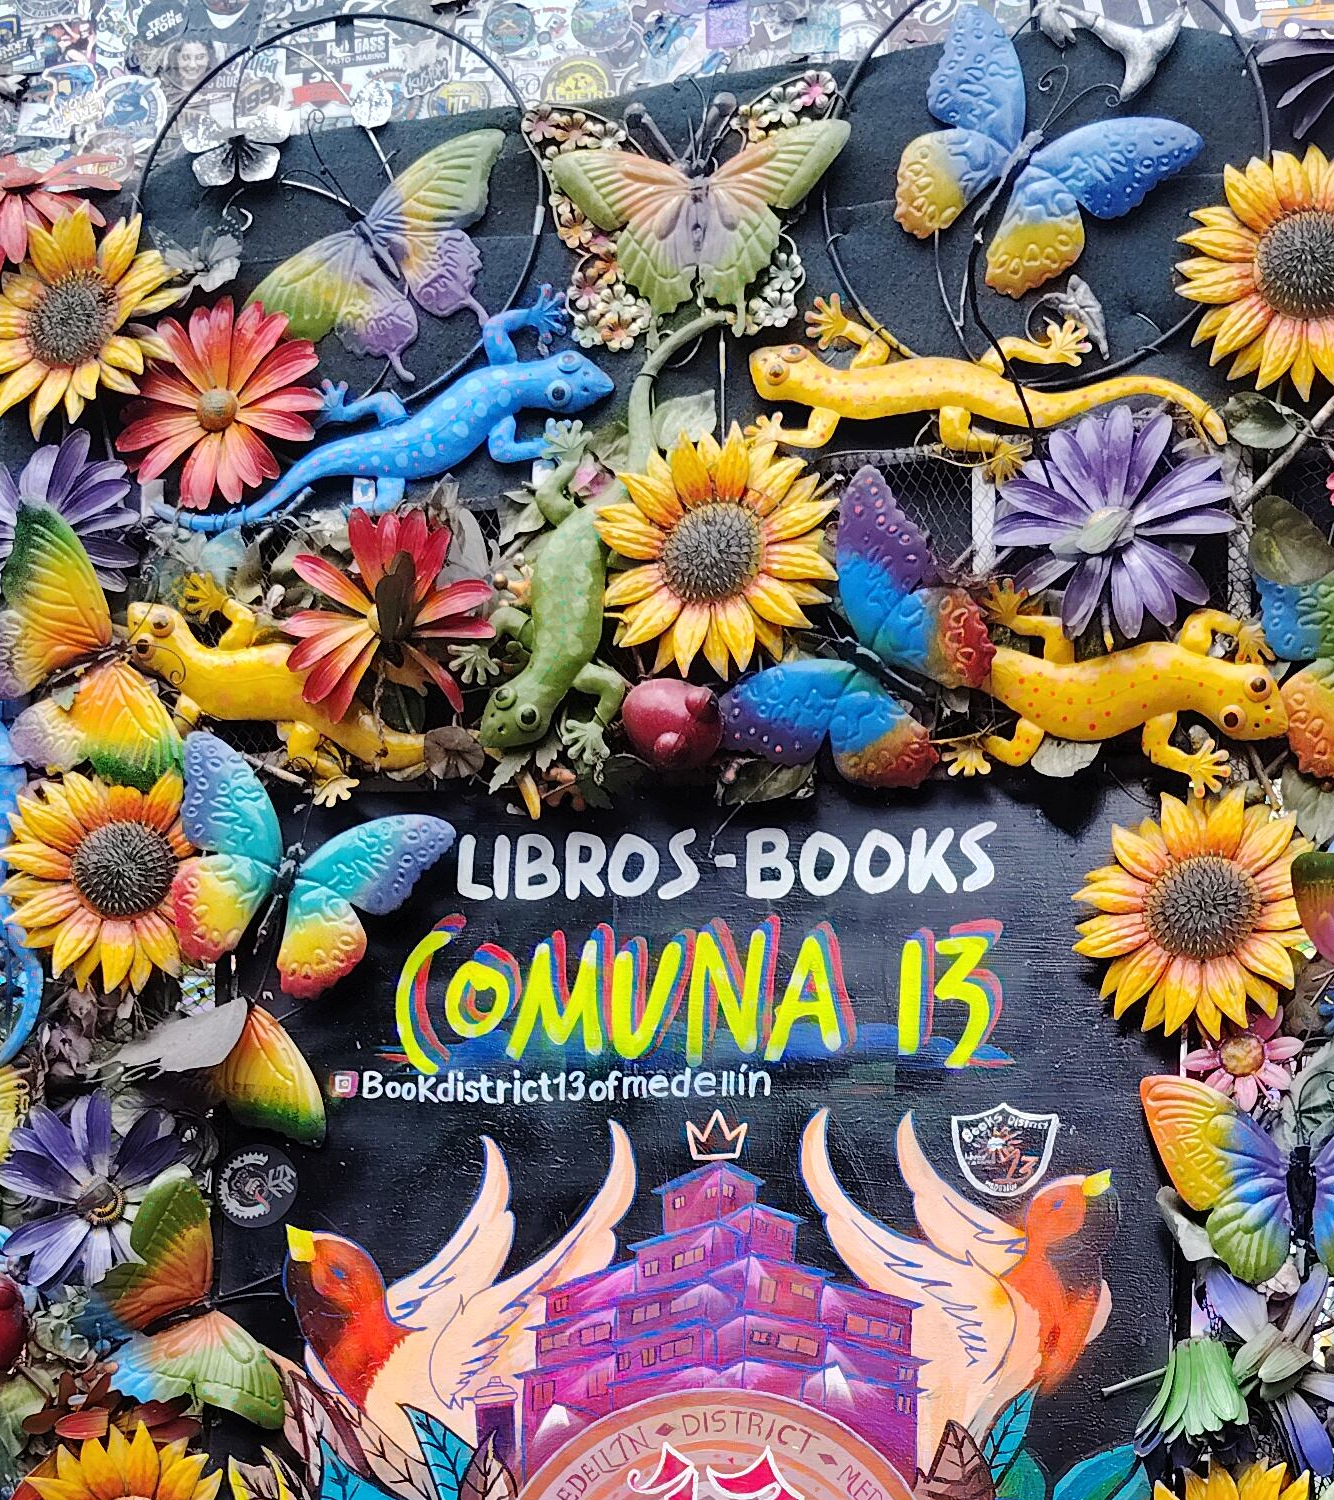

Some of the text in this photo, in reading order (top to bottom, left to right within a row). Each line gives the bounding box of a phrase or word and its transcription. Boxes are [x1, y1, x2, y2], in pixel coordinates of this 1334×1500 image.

[146, 13, 183, 40] STORE
[147, 10, 175, 29] TECH
[395, 914, 1005, 1075] COMUNA 13
[681, 1409, 821, 1455] DISTRICT
